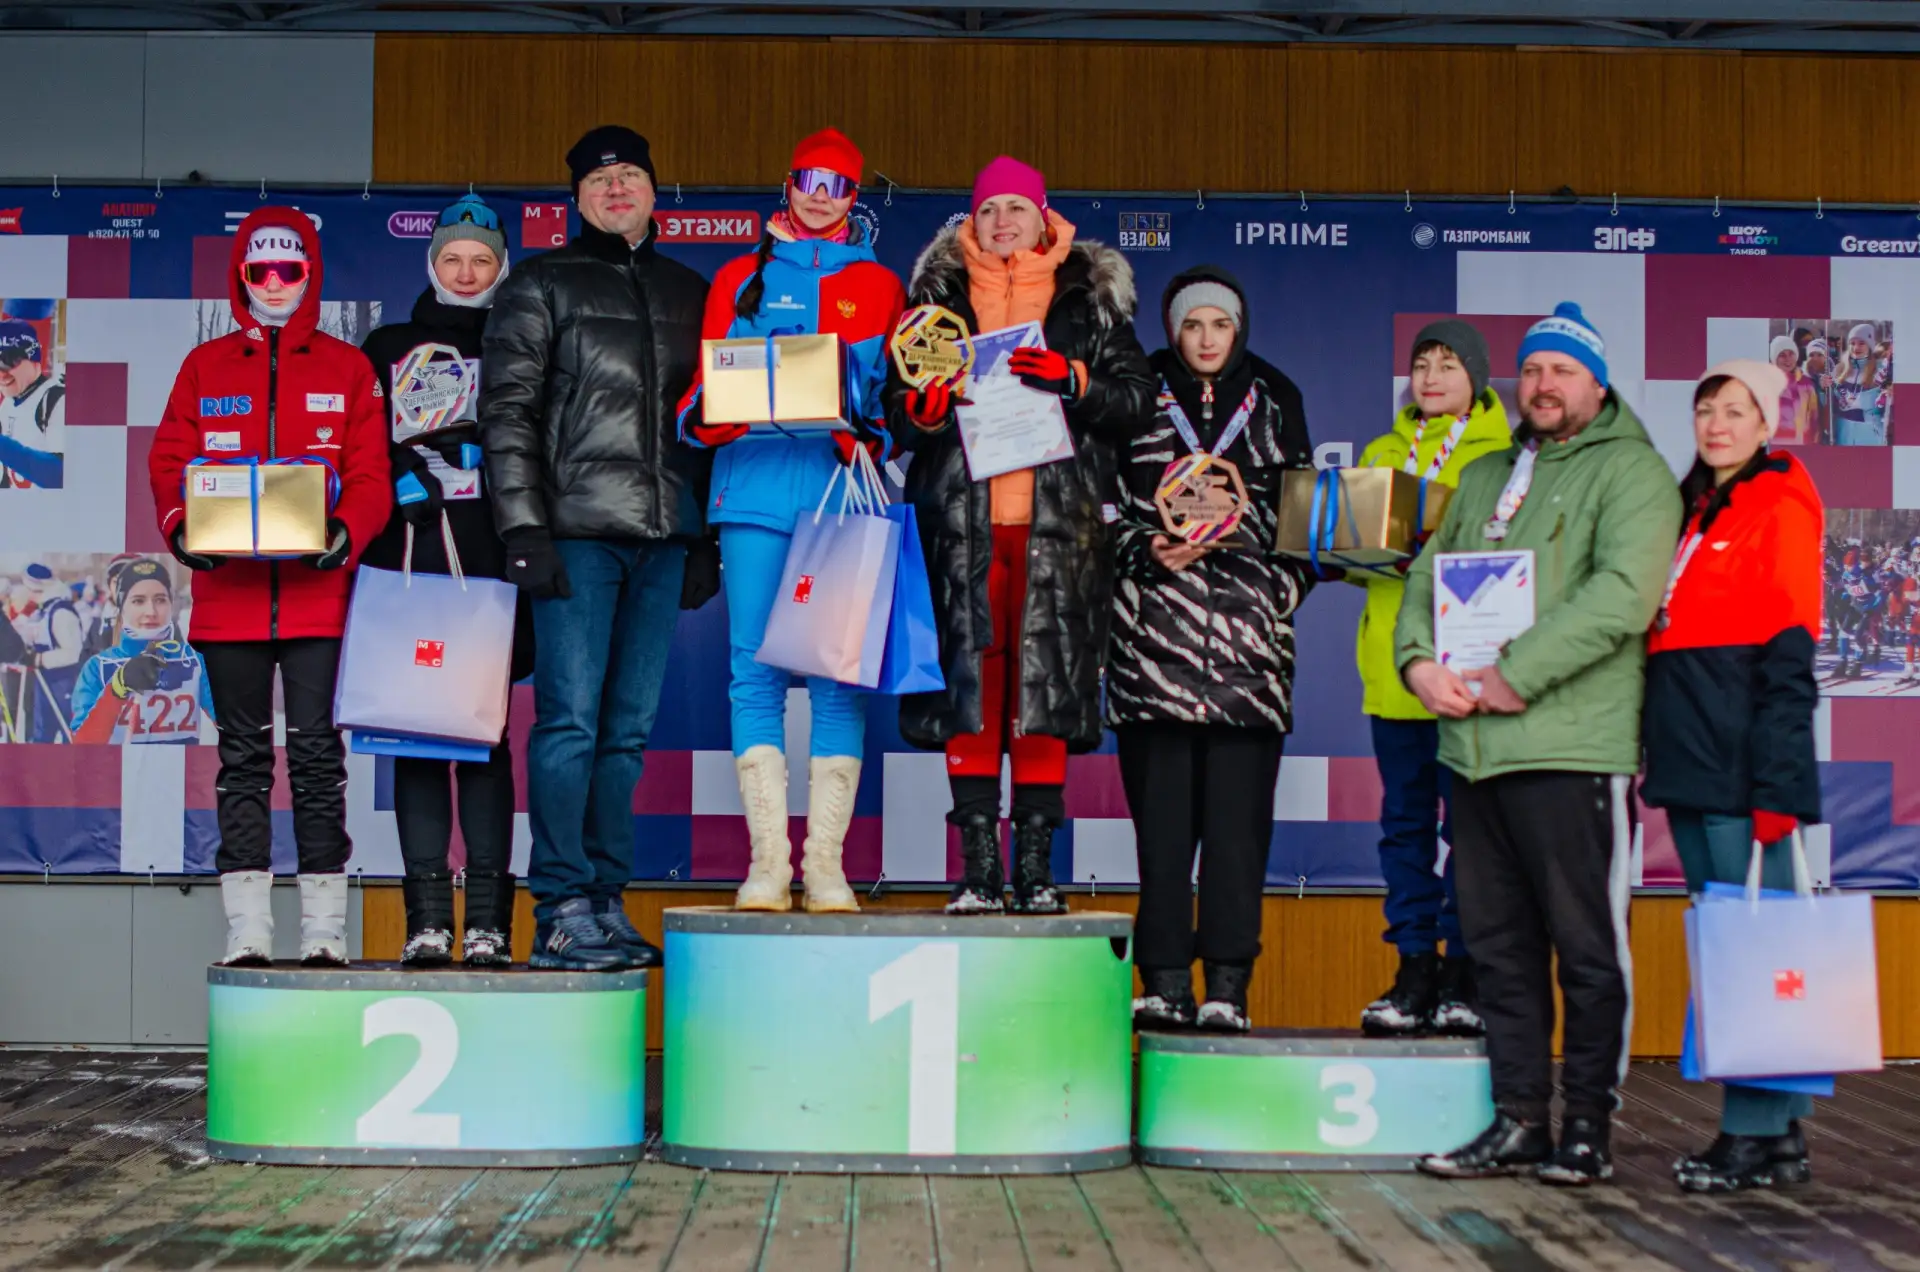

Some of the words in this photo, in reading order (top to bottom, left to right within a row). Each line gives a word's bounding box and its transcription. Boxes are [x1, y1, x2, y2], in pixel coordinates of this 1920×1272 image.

[112, 218, 143, 228] QUEST
[396, 217, 435, 232] ЧИК
[666, 218, 752, 236] этажи
[1119, 231, 1170, 247] ВЗЛОМ
[1235, 222, 1348, 246] iPRIME
[1443, 230, 1531, 244] ГАЗПРОМБАНК
[1730, 248, 1767, 256] ТАМБОВ
[200, 395, 252, 417] RUS
[117, 694, 197, 734] 422
[868, 942, 959, 1155] 1
[356, 995, 461, 1147] 2
[1318, 1063, 1379, 1147] 3
